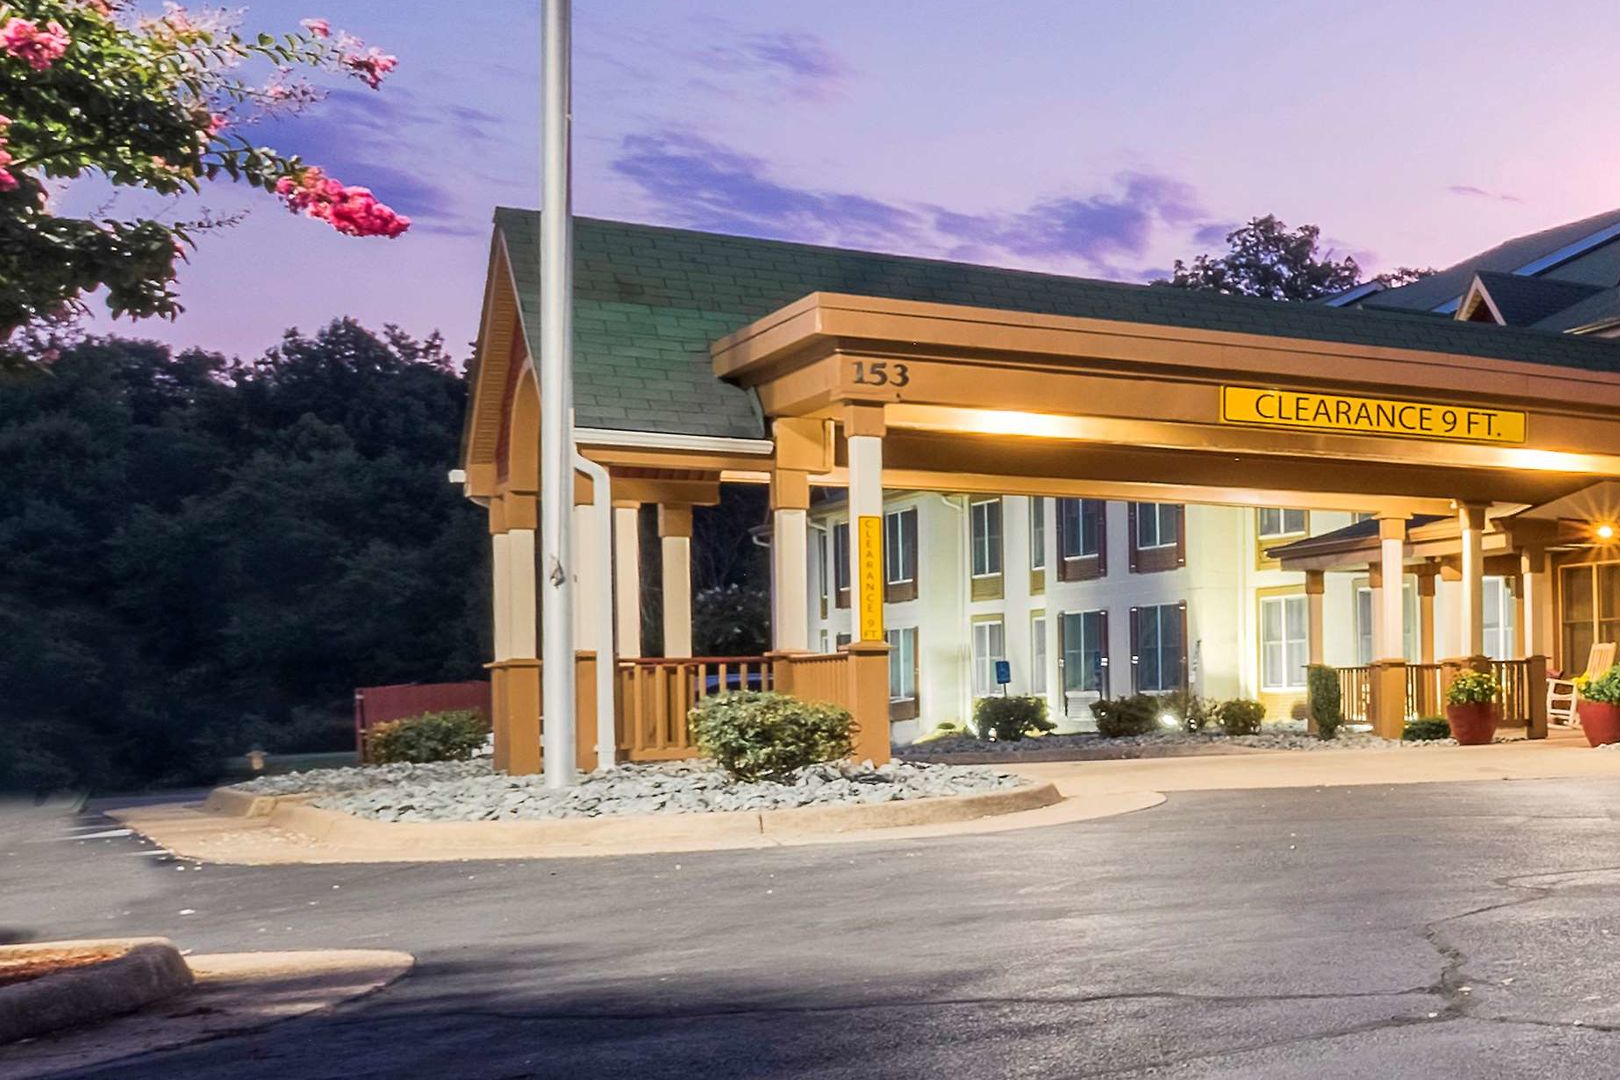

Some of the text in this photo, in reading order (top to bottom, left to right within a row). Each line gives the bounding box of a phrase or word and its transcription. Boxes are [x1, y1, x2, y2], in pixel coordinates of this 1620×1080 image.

[852, 361, 910, 387] 153
[1255, 393, 1502, 437] CLEARANCE 9 FT.
[864, 520, 875, 613] CLEARANCE
